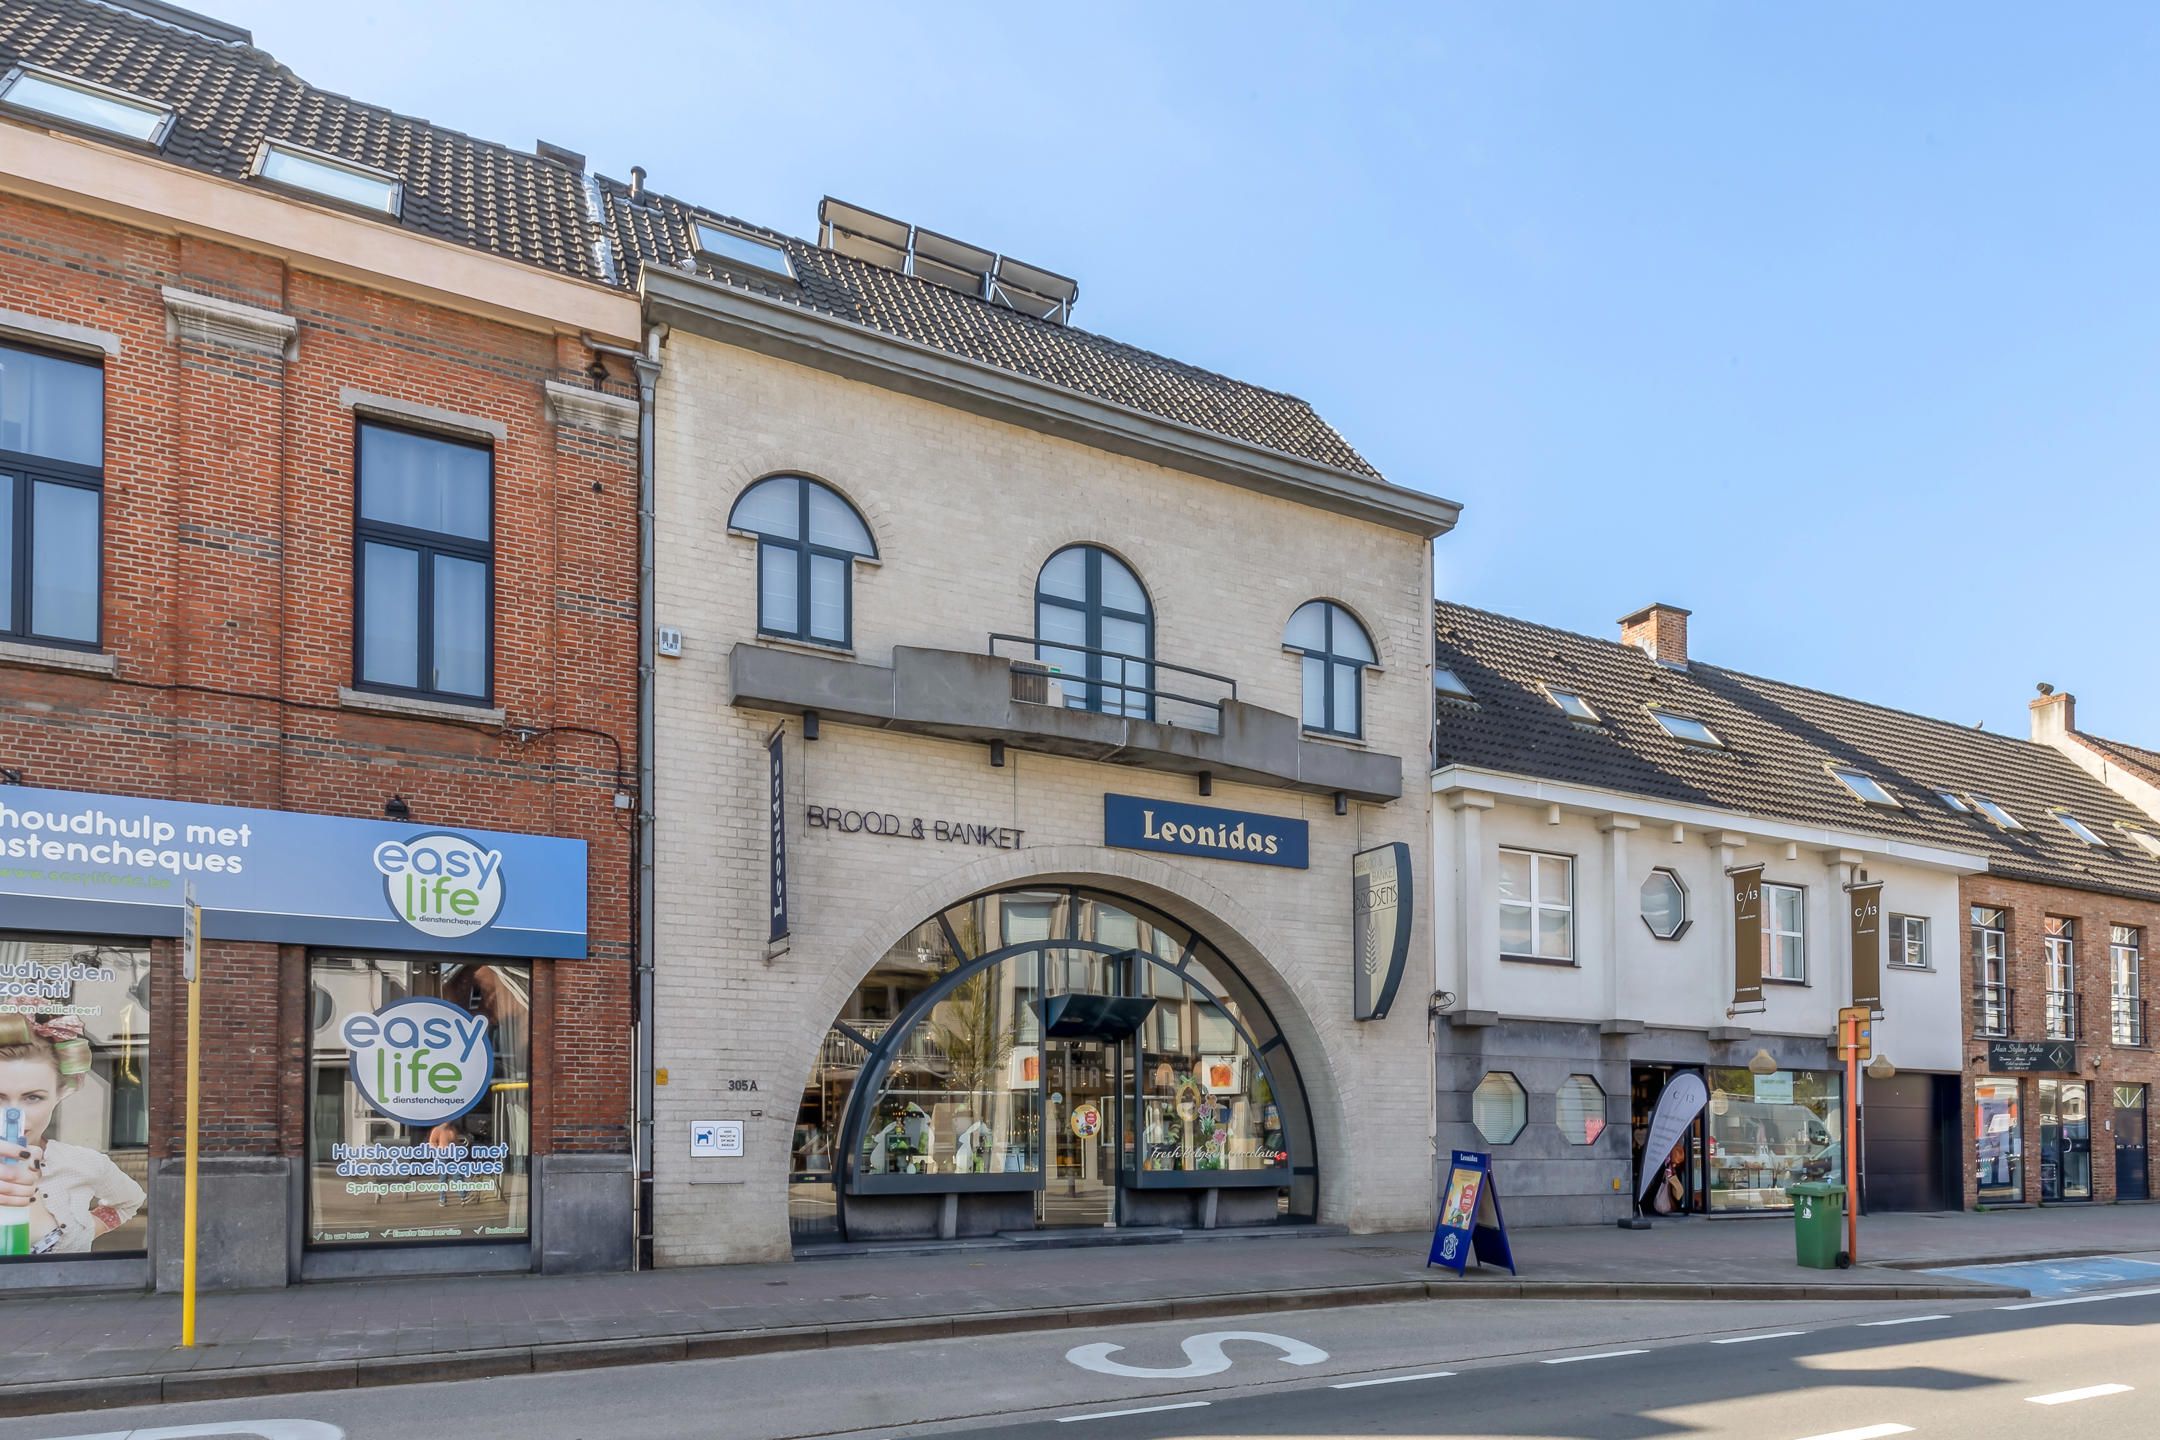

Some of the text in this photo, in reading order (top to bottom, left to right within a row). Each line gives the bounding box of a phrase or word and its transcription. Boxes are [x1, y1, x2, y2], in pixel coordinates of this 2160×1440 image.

[186, 824, 252, 848] met
[772, 759, 784, 919] Leonidas
[807, 805, 1025, 850] BROOD & BANKET
[1143, 810, 1278, 855] Leonidas
[0, 833, 243, 875] stencheques
[378, 845, 498, 890] easy
[406, 873, 479, 920] life
[418, 915, 482, 926] dienstencheques
[343, 1015, 484, 1063] easy
[377, 1048, 462, 1103] life
[392, 1096, 465, 1105] dienstencheques
[333, 1143, 508, 1161] Huishoudhulp met
[337, 1160, 503, 1177] dienstencheques
[347, 1182, 388, 1195] Spring
[390, 1181, 416, 1193] snel
[450, 1180, 494, 1192] binnen!
